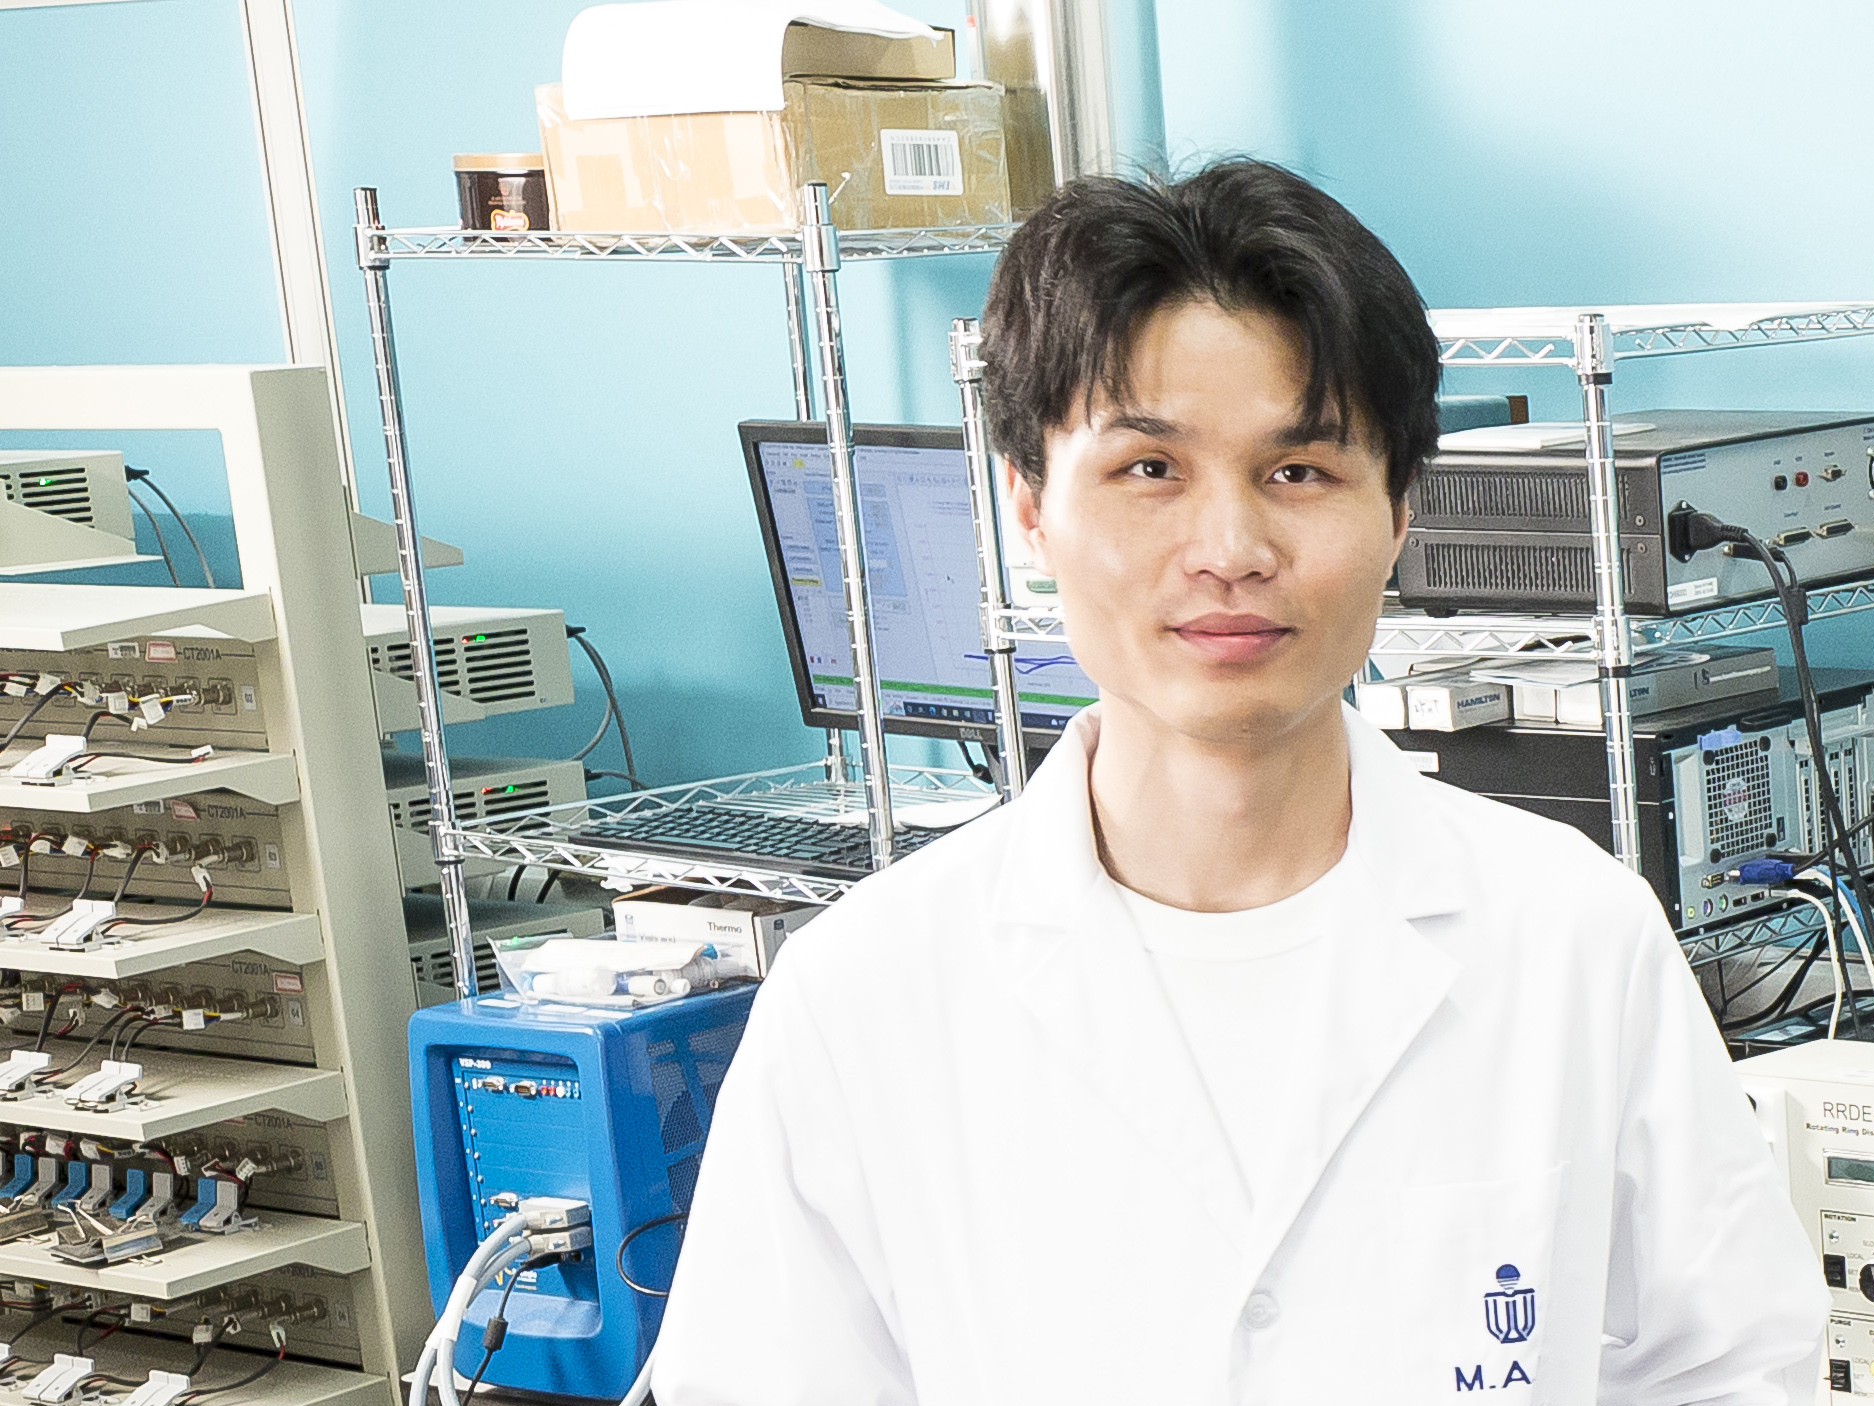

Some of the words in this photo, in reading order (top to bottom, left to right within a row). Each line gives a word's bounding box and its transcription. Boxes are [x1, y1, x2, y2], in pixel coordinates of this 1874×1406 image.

[183, 647, 222, 661] CT2001A
[1457, 693, 1500, 709] HAMILTON
[207, 804, 246, 819] CT2001A
[707, 921, 742, 934] Thermo
[1806, 1122, 1839, 1134] Rotating
[1842, 1126, 1859, 1136] Ring
[1824, 1213, 1856, 1222] ROTATION
[1846, 1252, 1865, 1260] LOCAL
[1830, 1318, 1851, 1326] PURGE
